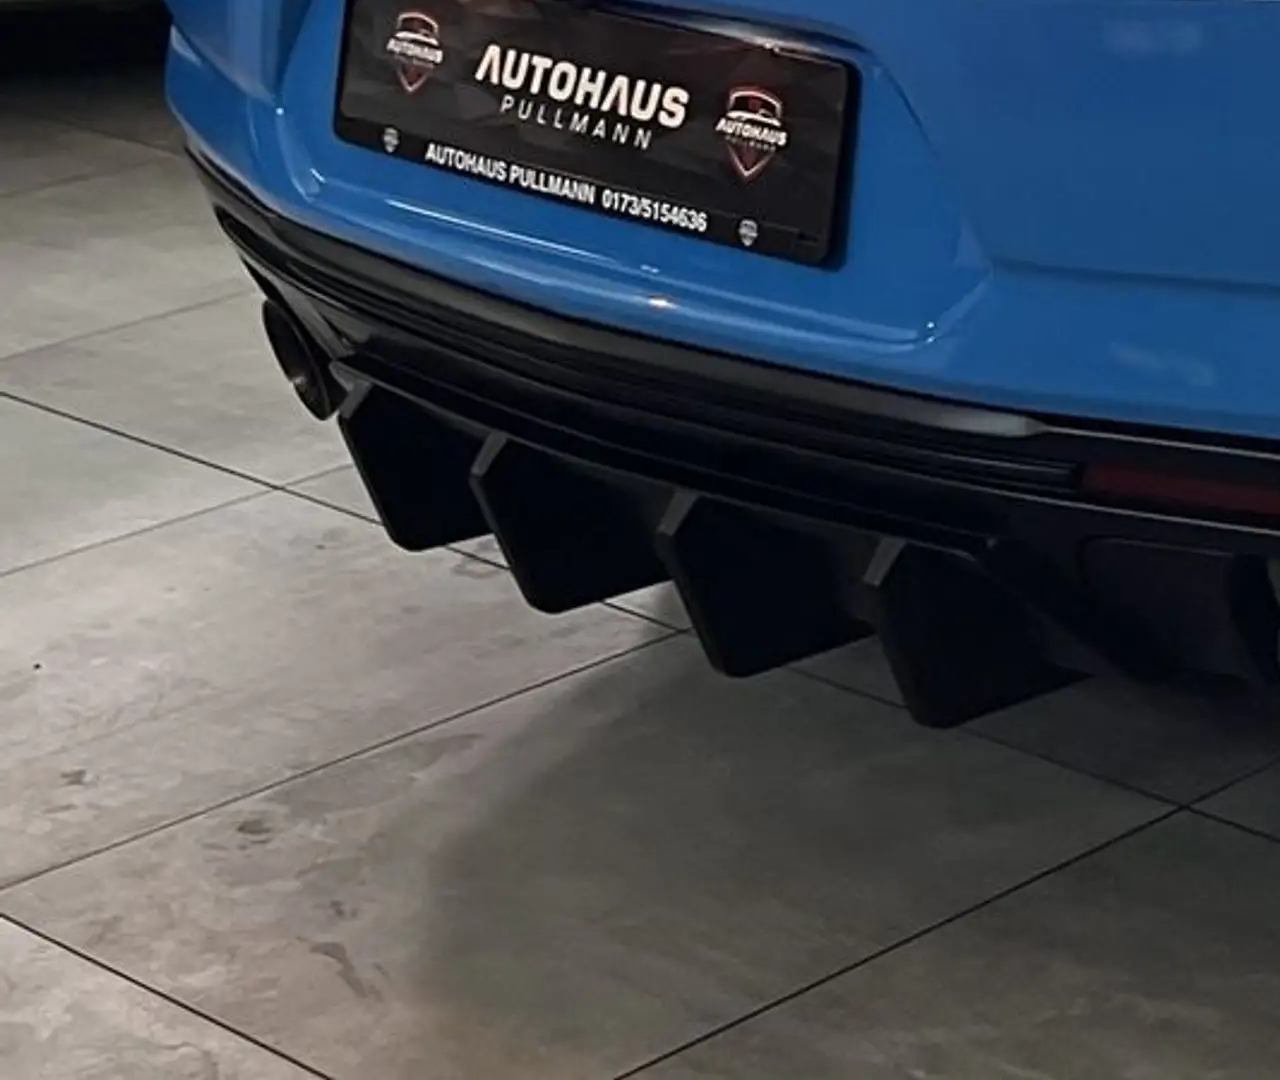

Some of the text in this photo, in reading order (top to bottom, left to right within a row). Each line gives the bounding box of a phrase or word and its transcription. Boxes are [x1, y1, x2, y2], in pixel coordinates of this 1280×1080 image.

[475, 43, 691, 129] AUTOHAUS
[500, 96, 653, 150] PULLMANN
[715, 118, 787, 146] AUTOHAUS
[425, 142, 708, 232] AUTOHAUS PULLMANN 0173/5154636
